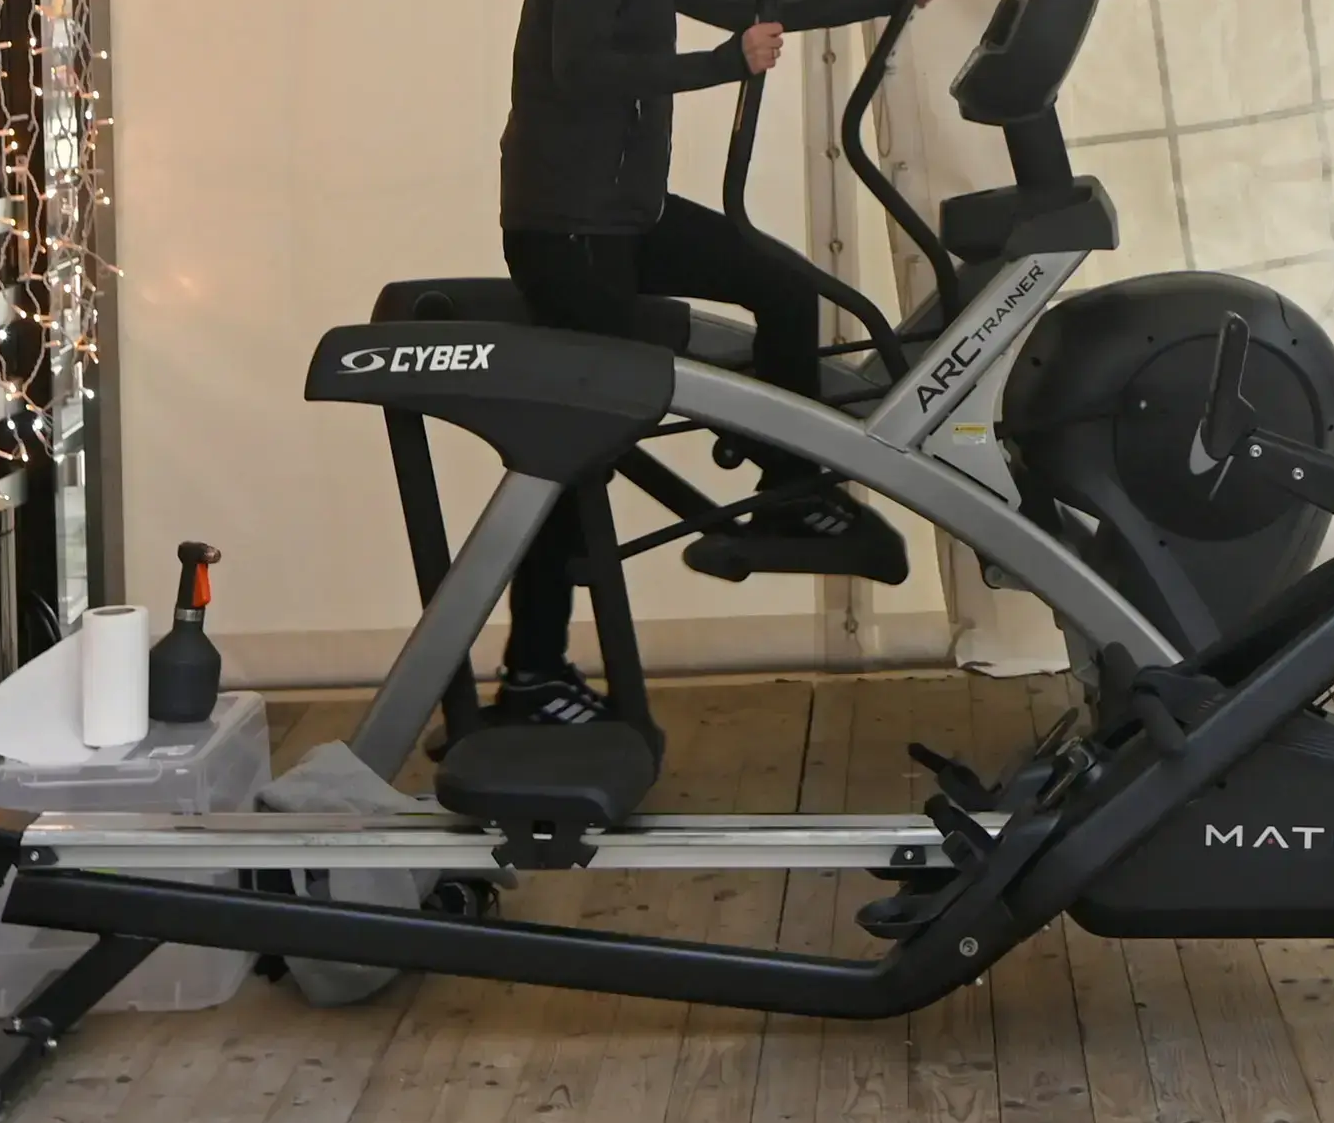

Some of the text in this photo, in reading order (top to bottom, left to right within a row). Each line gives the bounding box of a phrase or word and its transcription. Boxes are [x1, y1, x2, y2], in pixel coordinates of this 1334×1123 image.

[389, 343, 496, 373] CYBEX
[916, 264, 1045, 414] ARC TRAINER
